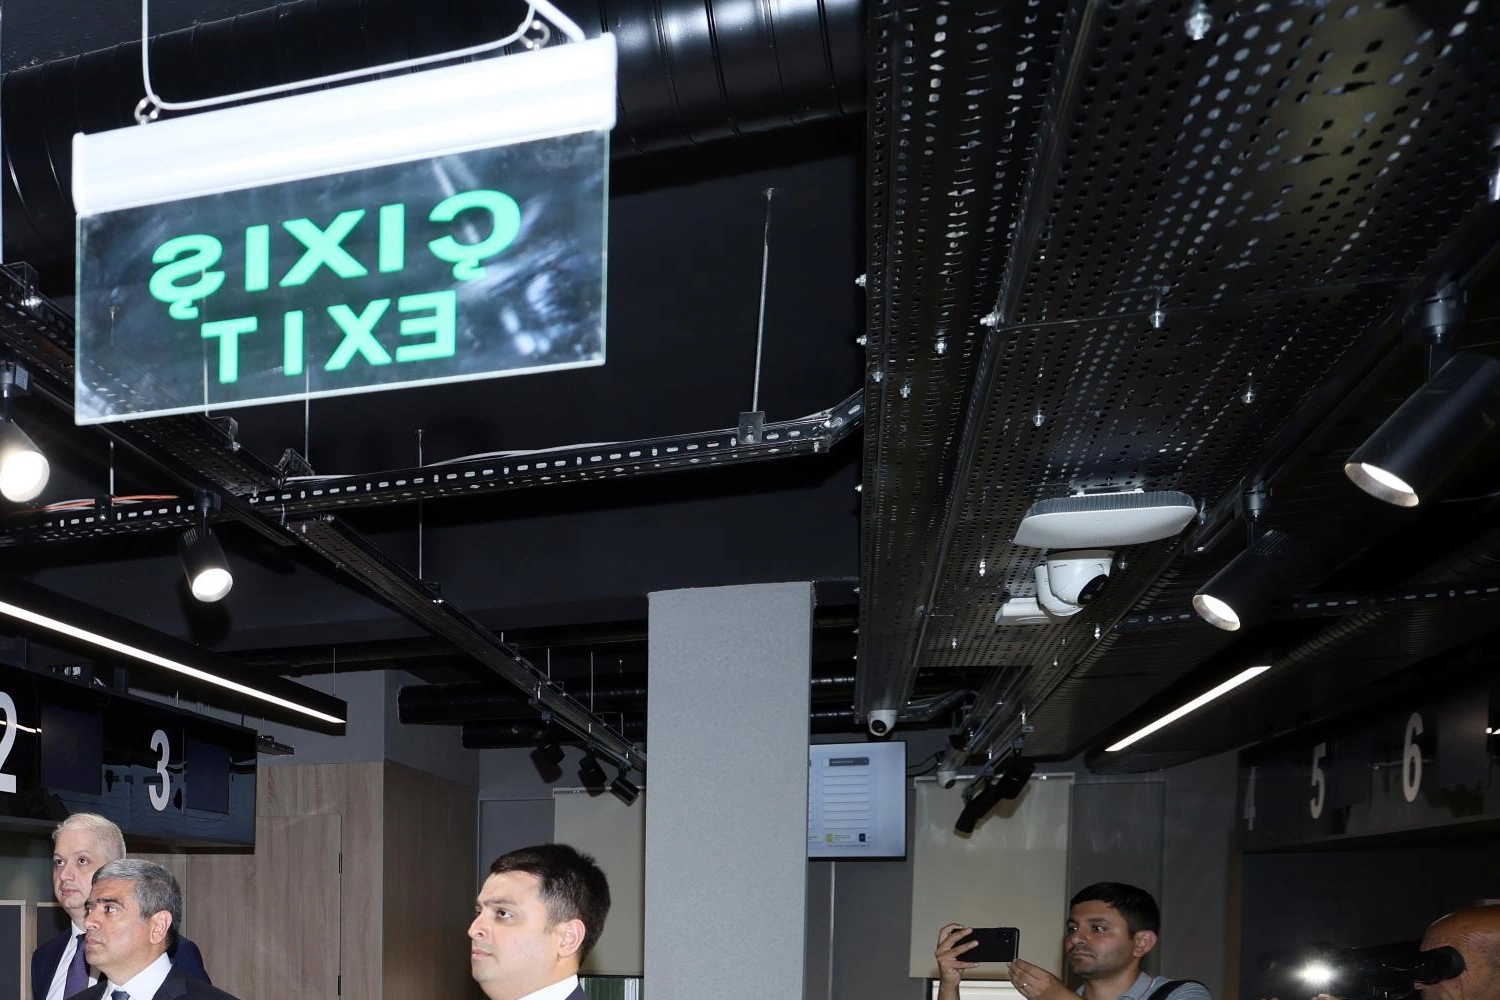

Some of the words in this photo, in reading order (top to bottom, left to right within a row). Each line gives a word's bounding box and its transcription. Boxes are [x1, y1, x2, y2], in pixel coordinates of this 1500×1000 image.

[148, 730, 171, 811] 3
[1309, 742, 1327, 820] 5
[1402, 712, 1424, 803] 6
[1243, 766, 1257, 831] 4
